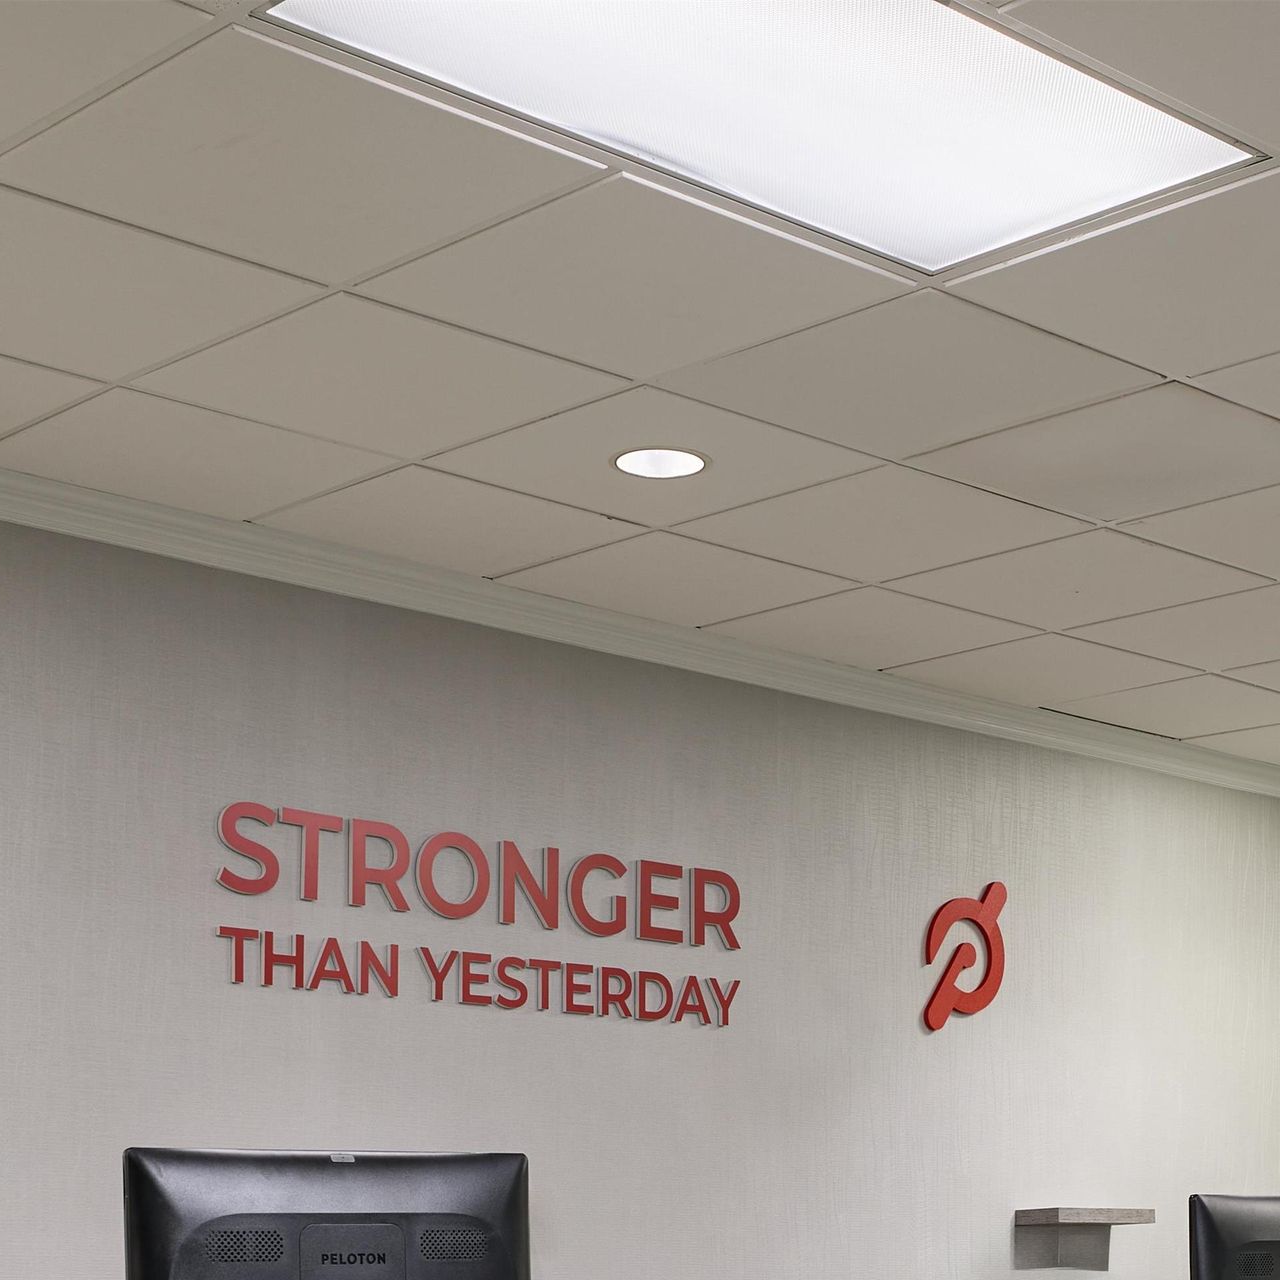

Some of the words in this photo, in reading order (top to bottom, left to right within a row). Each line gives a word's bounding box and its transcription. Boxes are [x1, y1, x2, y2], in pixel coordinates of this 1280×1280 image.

[216, 801, 741, 950] STRONGER
[216, 925, 400, 999] THAN
[417, 946, 741, 1027] YESTERDAY
[321, 1252, 386, 1265] PELOTON
